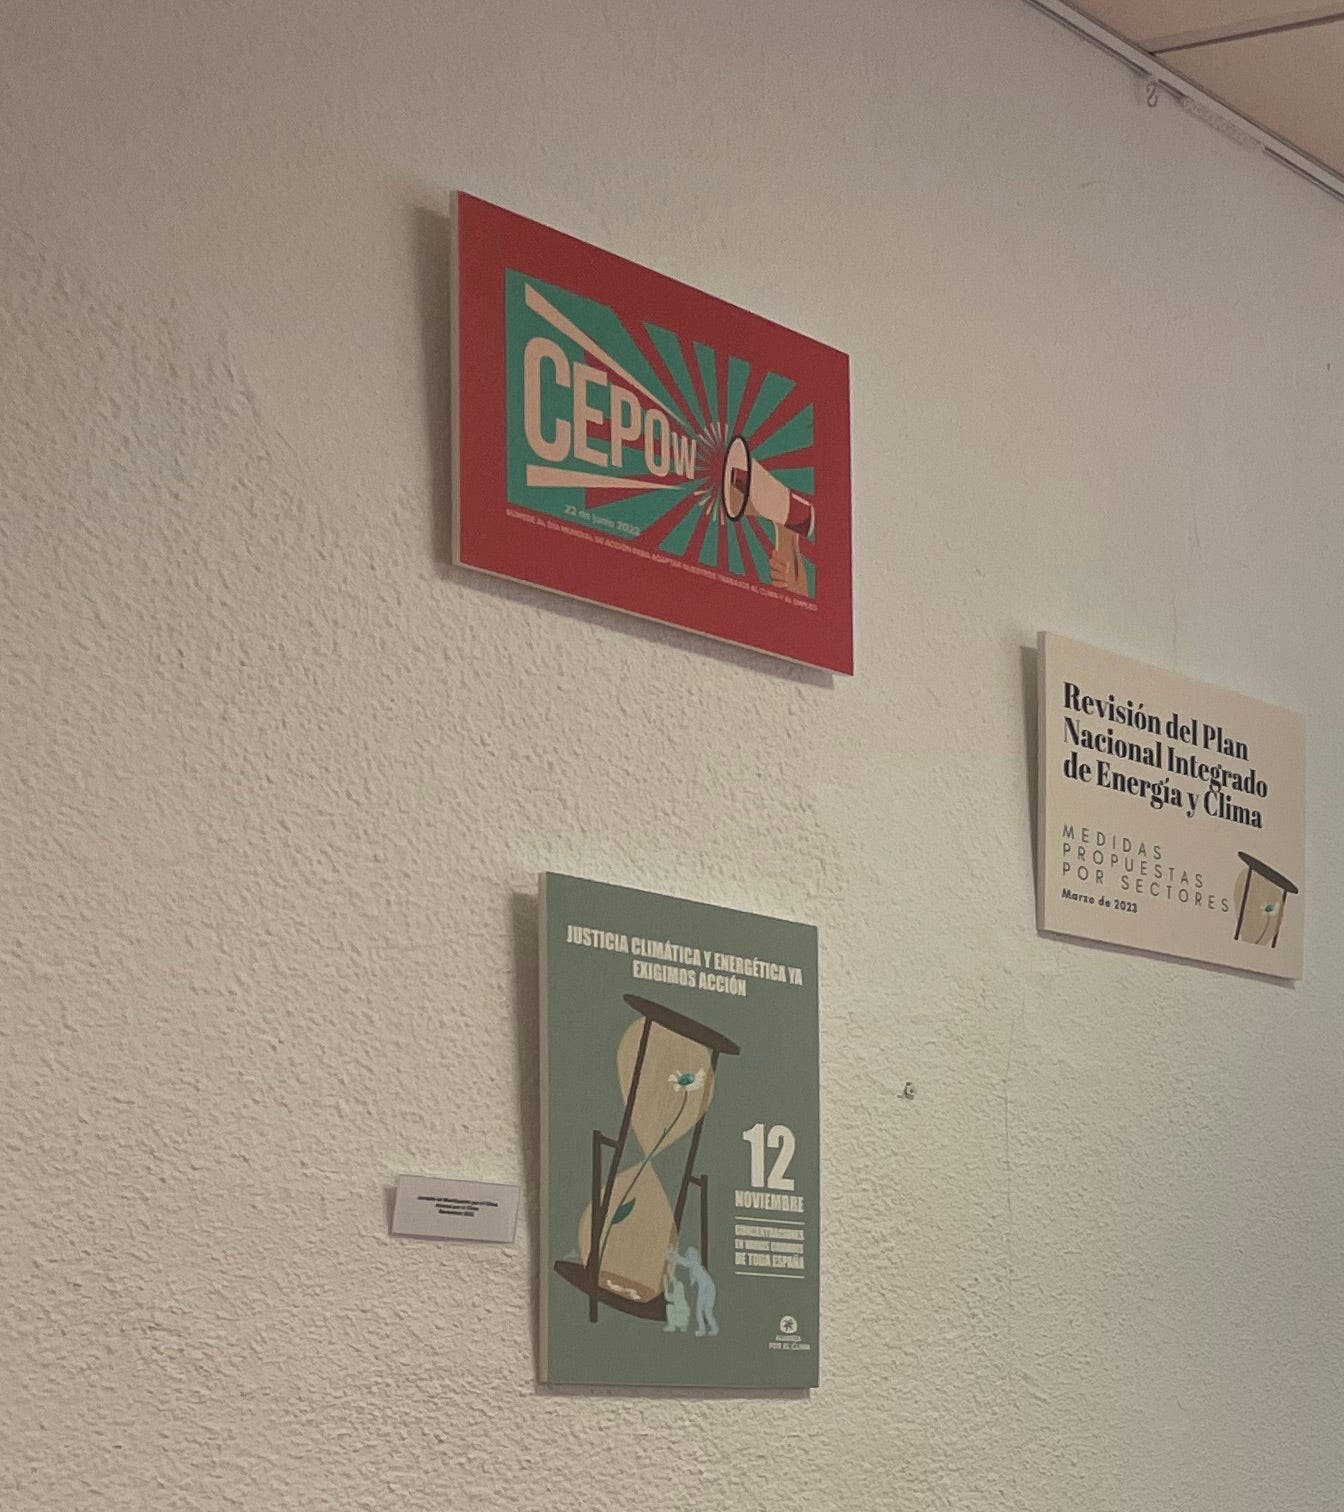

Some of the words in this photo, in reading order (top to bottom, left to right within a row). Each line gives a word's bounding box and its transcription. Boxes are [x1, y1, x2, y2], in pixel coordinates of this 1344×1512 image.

[524, 337, 697, 480] CEPOW
[564, 504, 577, 517] 22
[592, 513, 616, 528] junio
[617, 520, 641, 536] 2022
[1064, 681, 1162, 736] Revisión
[1165, 713, 1198, 746] del
[1203, 723, 1249, 761] Plan
[1064, 716, 1162, 769] Nacional
[1167, 746, 1268, 798] Integrado
[1063, 751, 1092, 783] de
[1096, 759, 1182, 810] Energía
[1186, 791, 1200, 818] y
[1203, 790, 1263, 829] Clima
[1062, 824, 1162, 861] MEDIDAS
[1063, 842, 1203, 889] PROPUESTAS
[1061, 888, 1095, 905] Marzo
[1098, 895, 1111, 908] de
[1114, 899, 1138, 914] 2023
[1063, 861, 1104, 885] POR
[1121, 875, 1229, 913] SECTORES
[566, 924, 628, 954] JUSTICIA
[631, 936, 701, 966] CLIMÁTICA
[703, 950, 711, 968] Y
[714, 952, 787, 984] ENERGÉTICA
[788, 967, 803, 986] YA
[633, 959, 696, 988] EXIGIMOS
[699, 970, 747, 997] ACCIÓN
[743, 1123, 795, 1191] 12
[735, 1190, 804, 1213] NOVIEMBRE
[735, 1252, 746, 1265] DE
[772, 1253, 805, 1270] ESPAÑA
